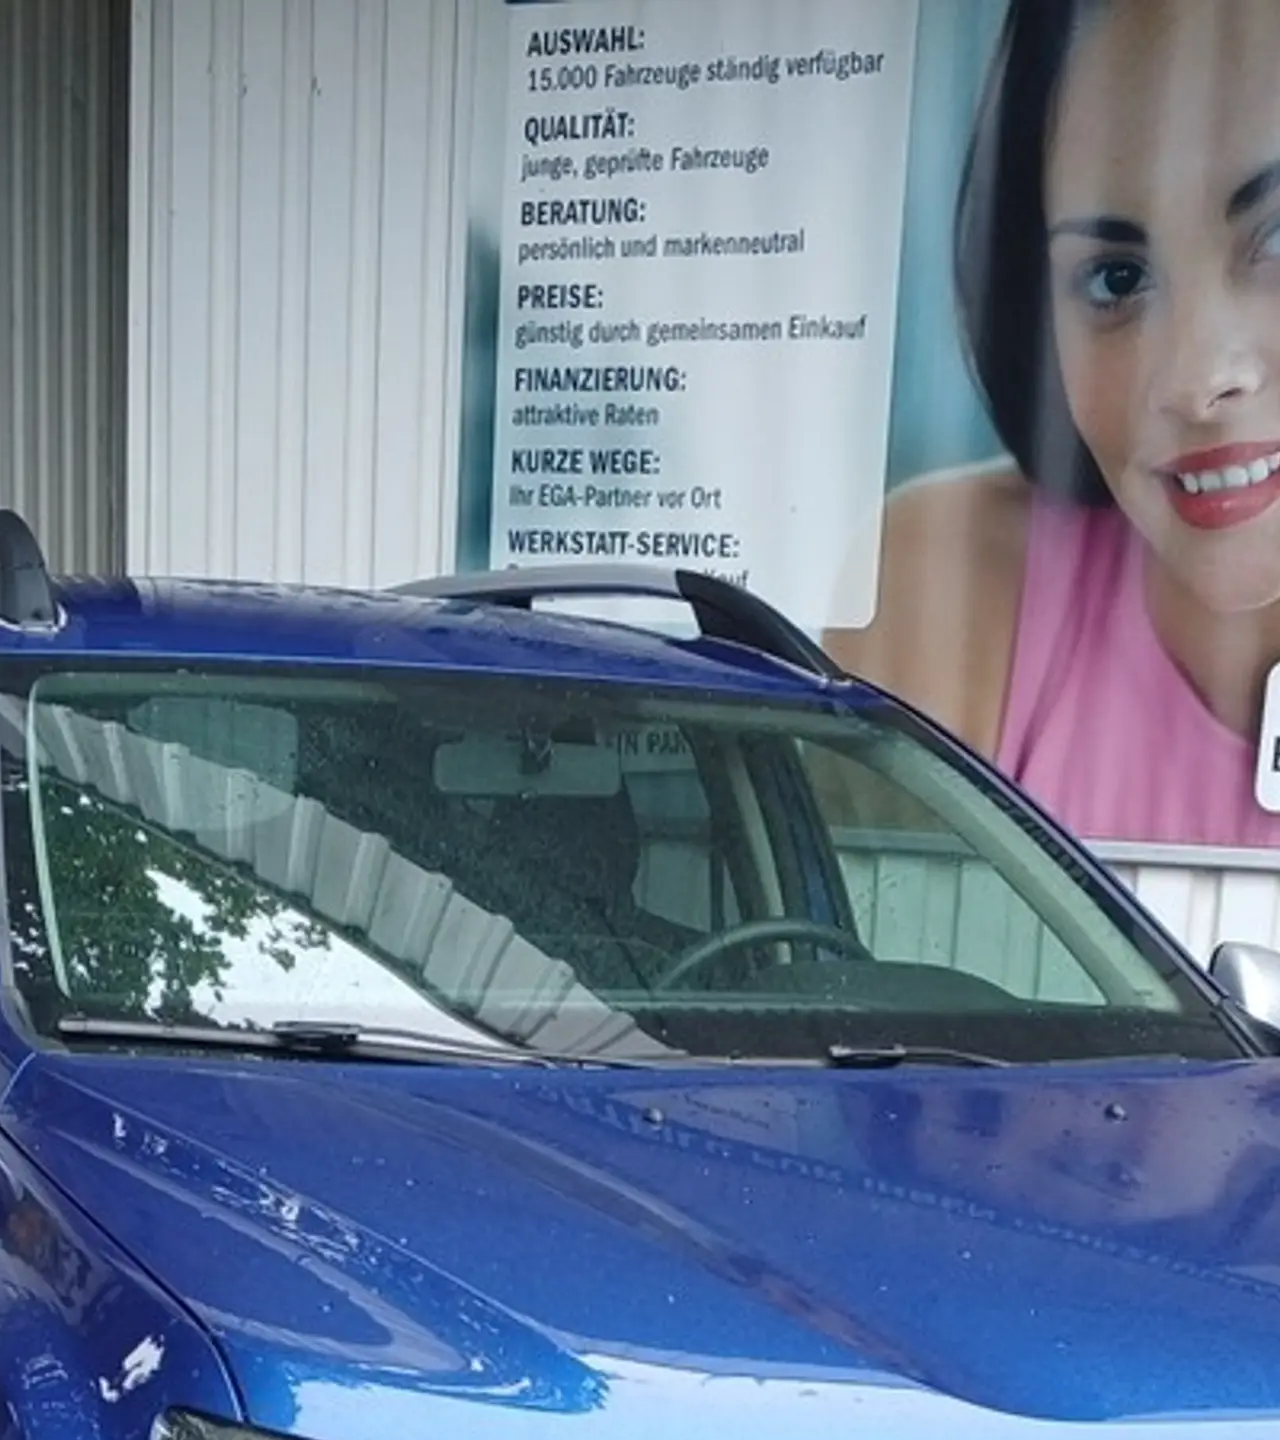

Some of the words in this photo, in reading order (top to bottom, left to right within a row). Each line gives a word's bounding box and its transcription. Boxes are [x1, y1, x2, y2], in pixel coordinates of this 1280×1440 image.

[527, 26, 645, 57] AUSWAHL:
[528, 64, 597, 92] 15.000
[604, 59, 701, 92] Fahrzeuge
[707, 55, 780, 85] ständig
[786, 49, 885, 80] verfügbar
[524, 108, 635, 145] QUALITÄT:
[520, 153, 578, 183] junge,
[584, 147, 664, 180] geprüfte
[670, 145, 769, 175] Fahrzeuge
[520, 197, 646, 227] BERATUNG:
[518, 234, 616, 265] persönlich
[621, 233, 658, 259] und
[662, 228, 805, 258] markenneutral
[517, 283, 604, 310] PREISE:
[514, 317, 584, 350] günstig
[588, 317, 642, 344] durch
[646, 315, 783, 347] gemeinsamen
[787, 313, 867, 340] Einkauf
[514, 367, 687, 393] FINANZIERUNG:
[512, 402, 600, 427] attraktive
[604, 402, 659, 427] Raten
[511, 449, 583, 474] KURZE
[589, 449, 661, 475] WEGE:
[509, 484, 534, 507] Ihr
[537, 484, 652, 509] EGA-Partner
[656, 489, 686, 509] vor
[690, 485, 722, 509] Ort
[508, 530, 740, 559] WERKSTATT-SERVICE:
